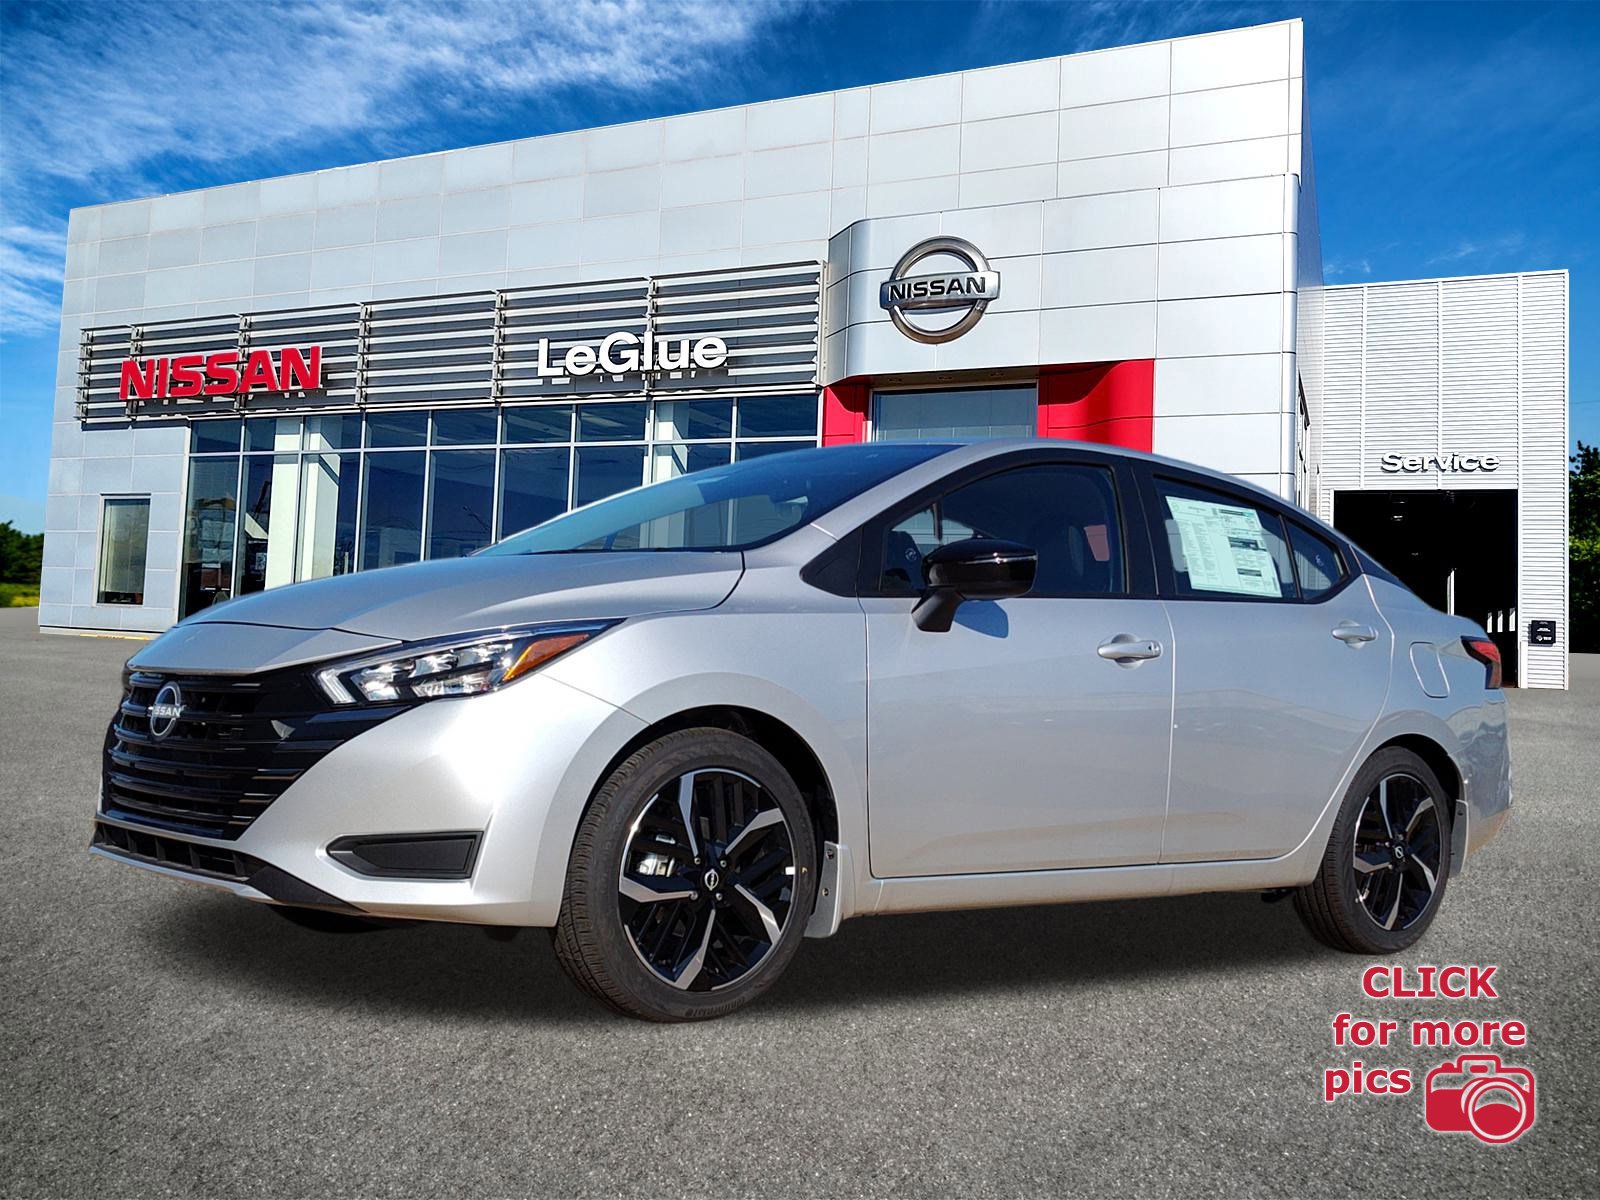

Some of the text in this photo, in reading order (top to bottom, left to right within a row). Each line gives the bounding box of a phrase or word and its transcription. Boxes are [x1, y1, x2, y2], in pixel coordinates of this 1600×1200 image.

[889, 276, 986, 301] NISSAN
[538, 331, 728, 377] LeGlue
[119, 346, 322, 400] NISSAN
[1381, 451, 1500, 473] Service
[148, 703, 182, 718] SSAN
